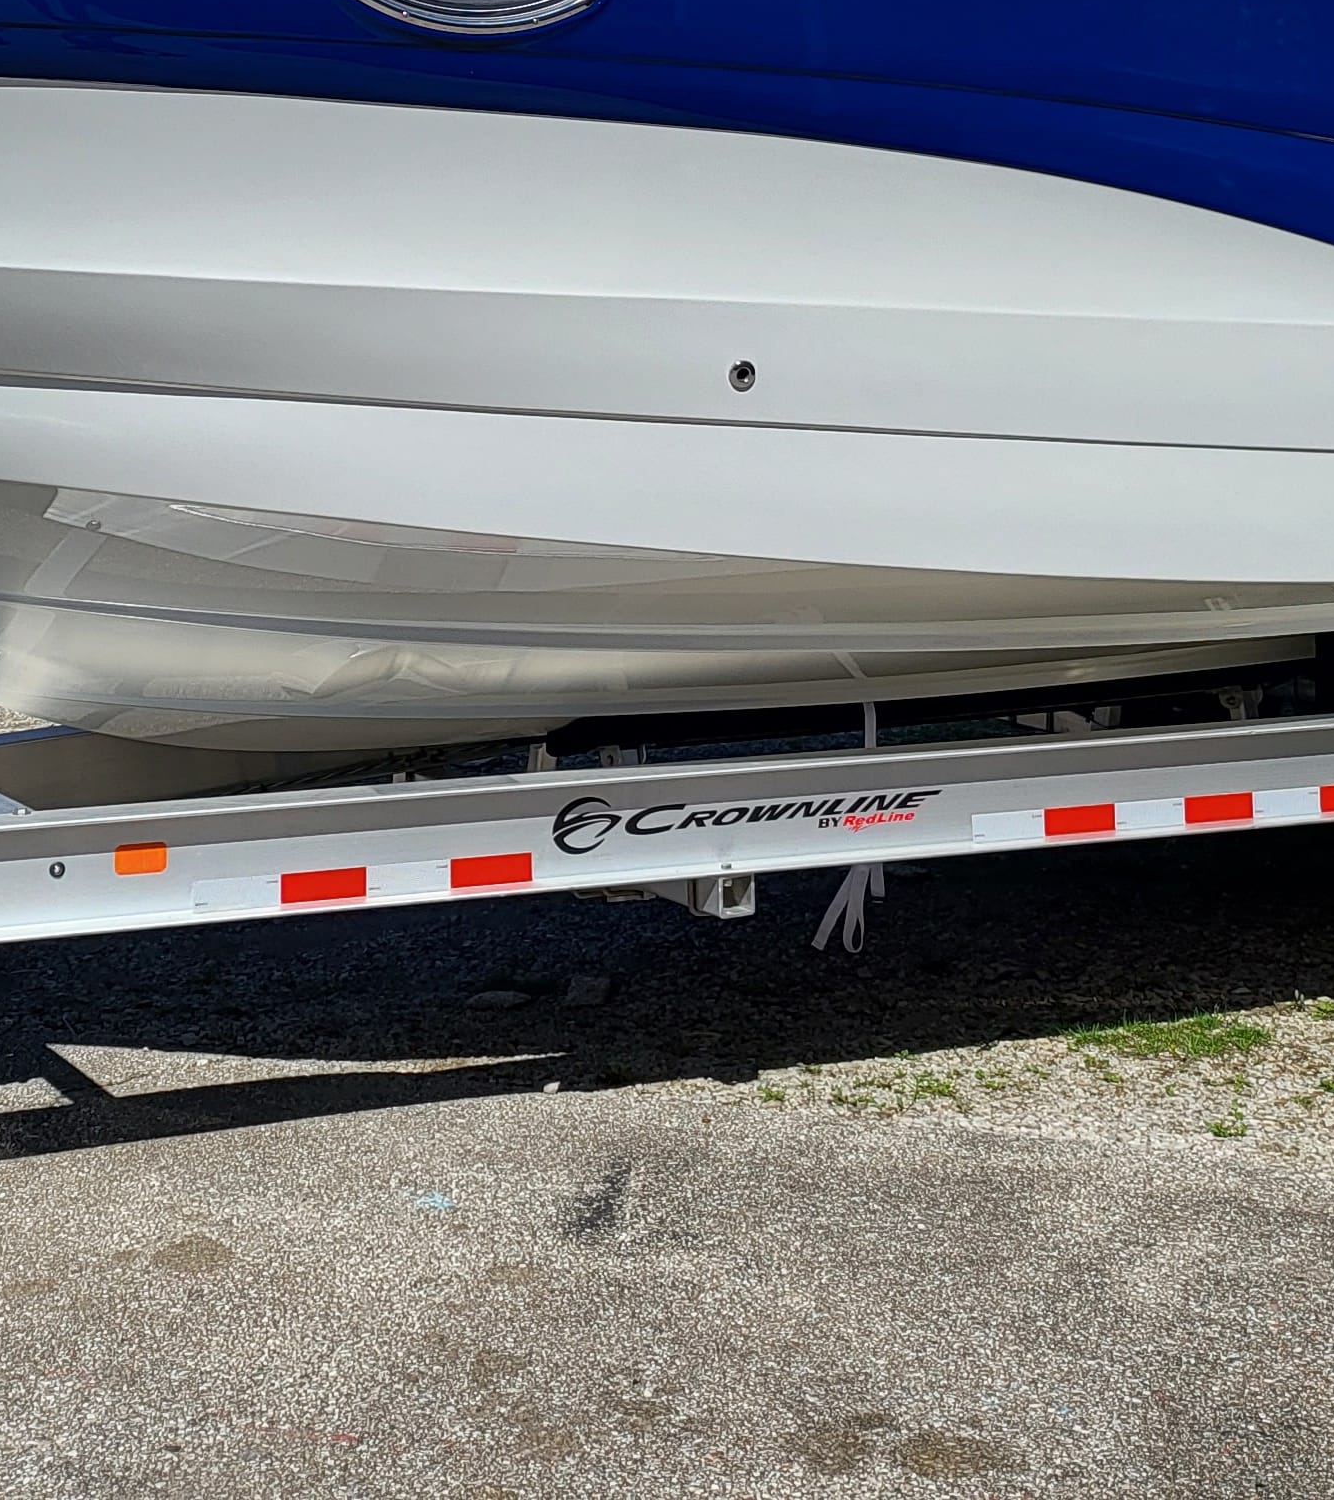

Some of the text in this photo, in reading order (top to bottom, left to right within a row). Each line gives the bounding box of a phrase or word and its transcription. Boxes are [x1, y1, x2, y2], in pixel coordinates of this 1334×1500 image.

[624, 789, 942, 835] CROWNLINE
[818, 811, 915, 829] BY RedLine
